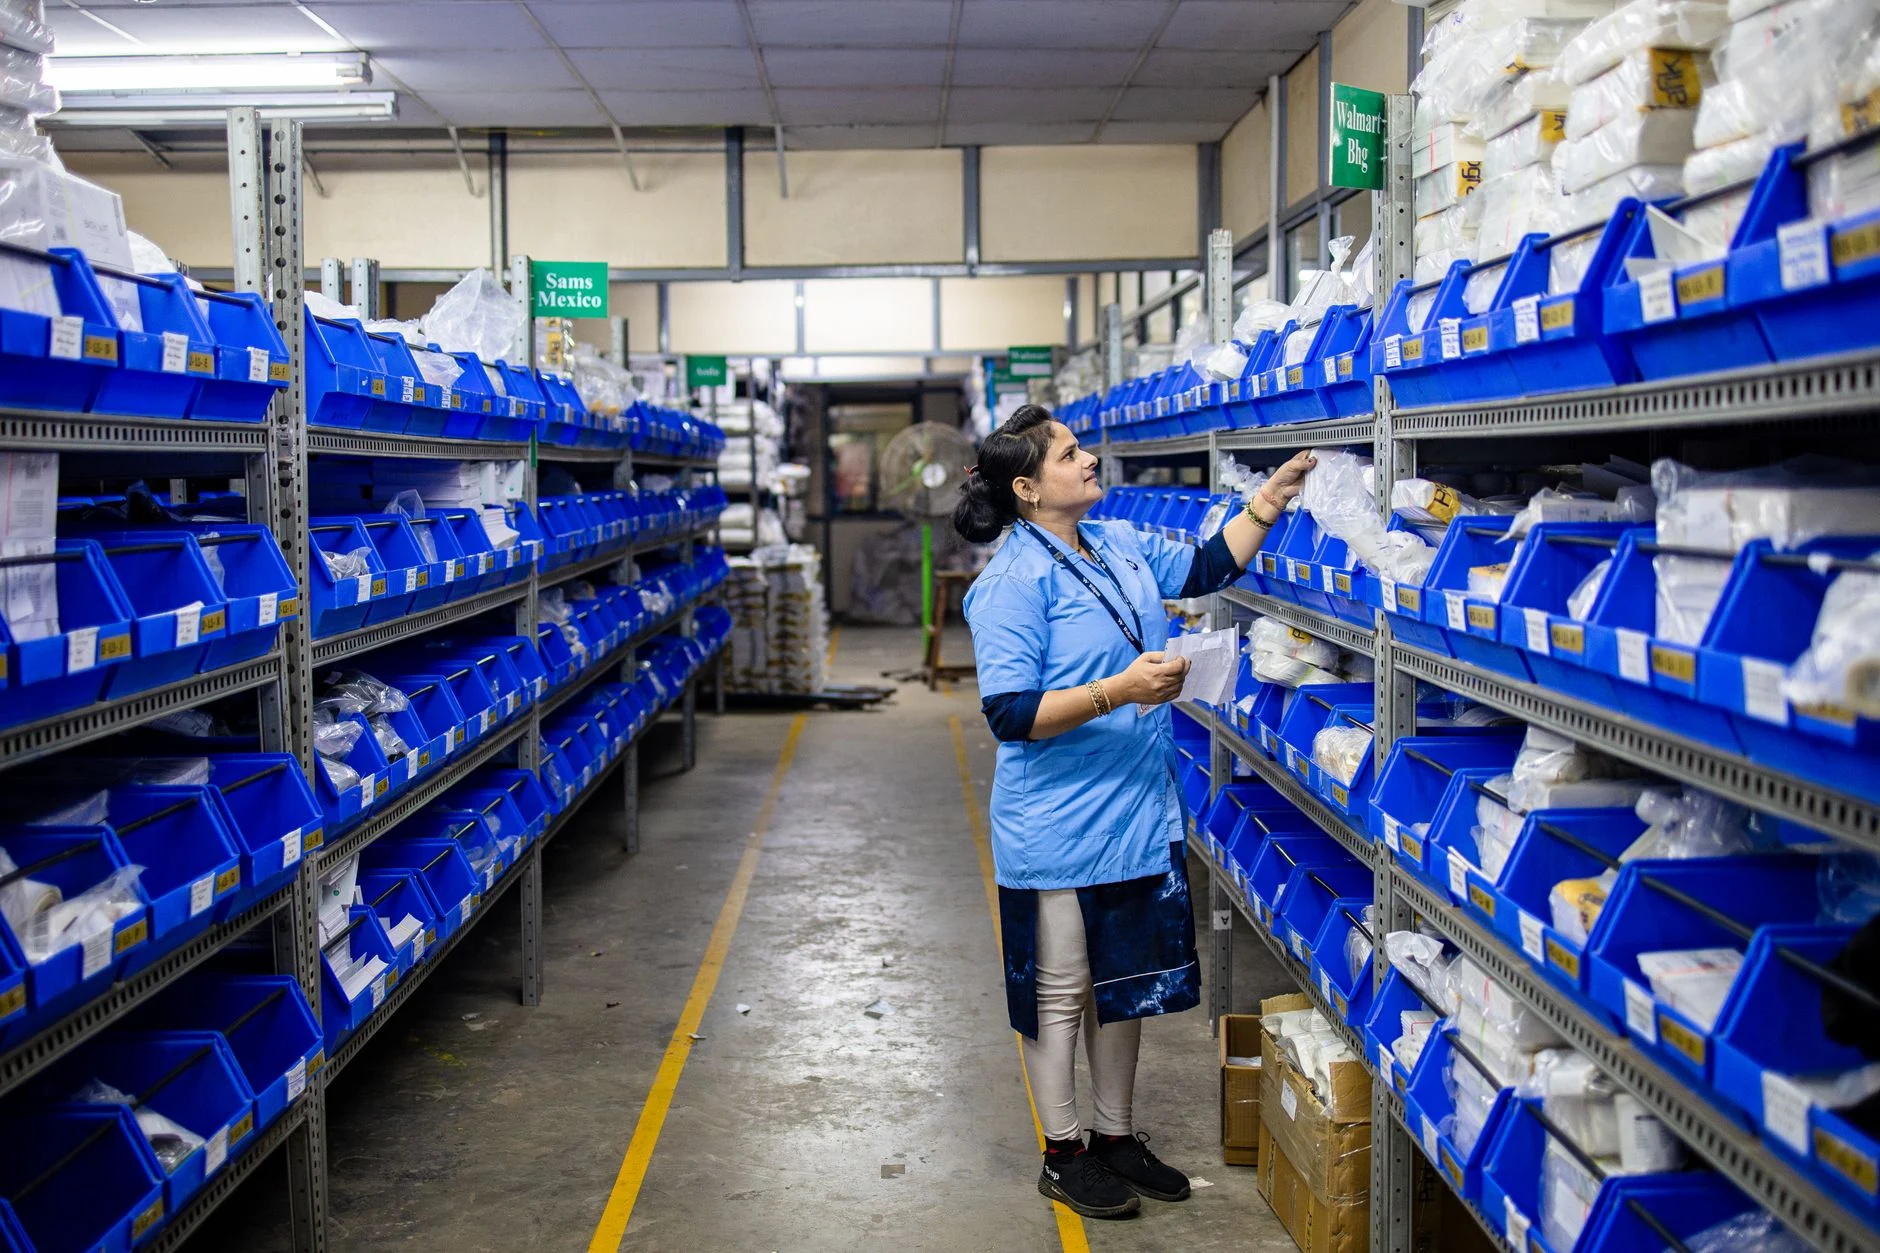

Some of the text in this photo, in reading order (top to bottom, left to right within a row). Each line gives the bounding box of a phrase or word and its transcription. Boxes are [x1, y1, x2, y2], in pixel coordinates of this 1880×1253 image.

[1336, 101, 1381, 134] Walmart
[1347, 138, 1369, 173] Bhg
[546, 272, 593, 290] Sams
[538, 291, 602, 308] Mexico
